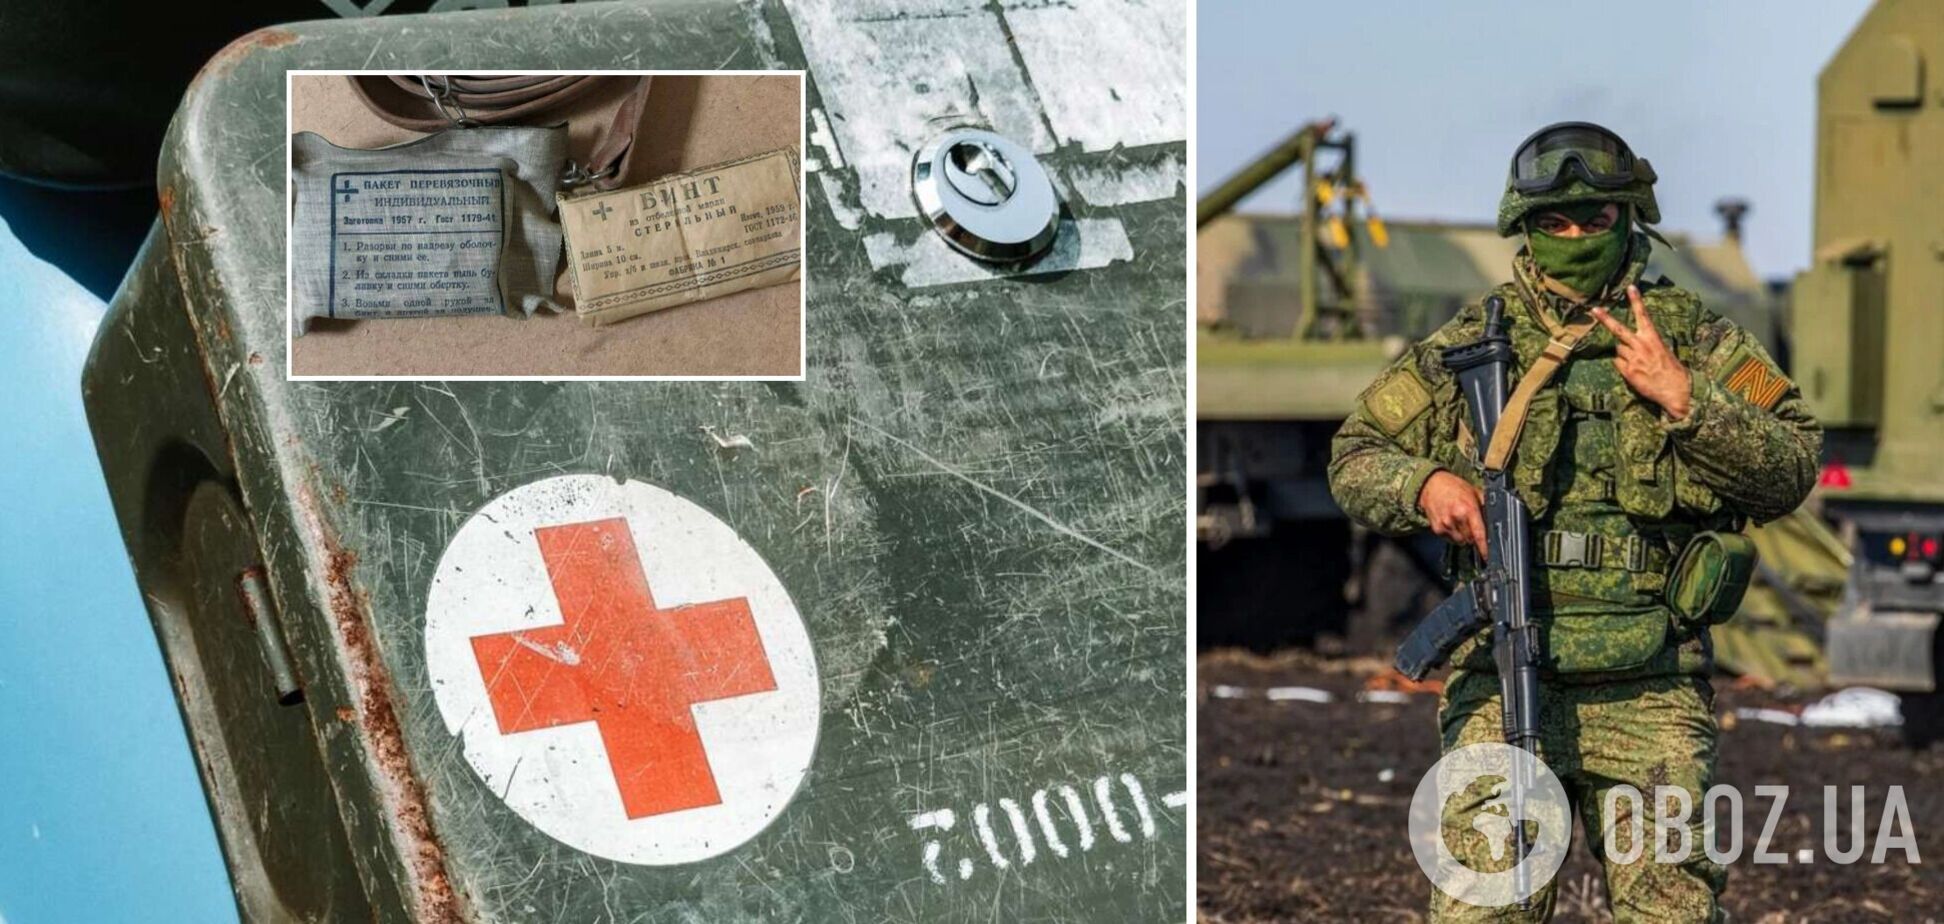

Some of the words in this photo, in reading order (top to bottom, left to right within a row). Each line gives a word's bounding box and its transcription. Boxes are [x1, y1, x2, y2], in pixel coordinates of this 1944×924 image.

[363, 180, 401, 190] ПАКЕТ
[640, 175, 720, 210] БИНТ
[375, 195, 490, 207] ИНДИВИДУАЛЬНЫЙ
[392, 215, 412, 224] 1957
[418, 216, 427, 225] г.
[343, 242, 351, 251] 1.
[401, 243, 412, 251] по
[616, 255, 626, 264] 10
[342, 271, 350, 280] 2.
